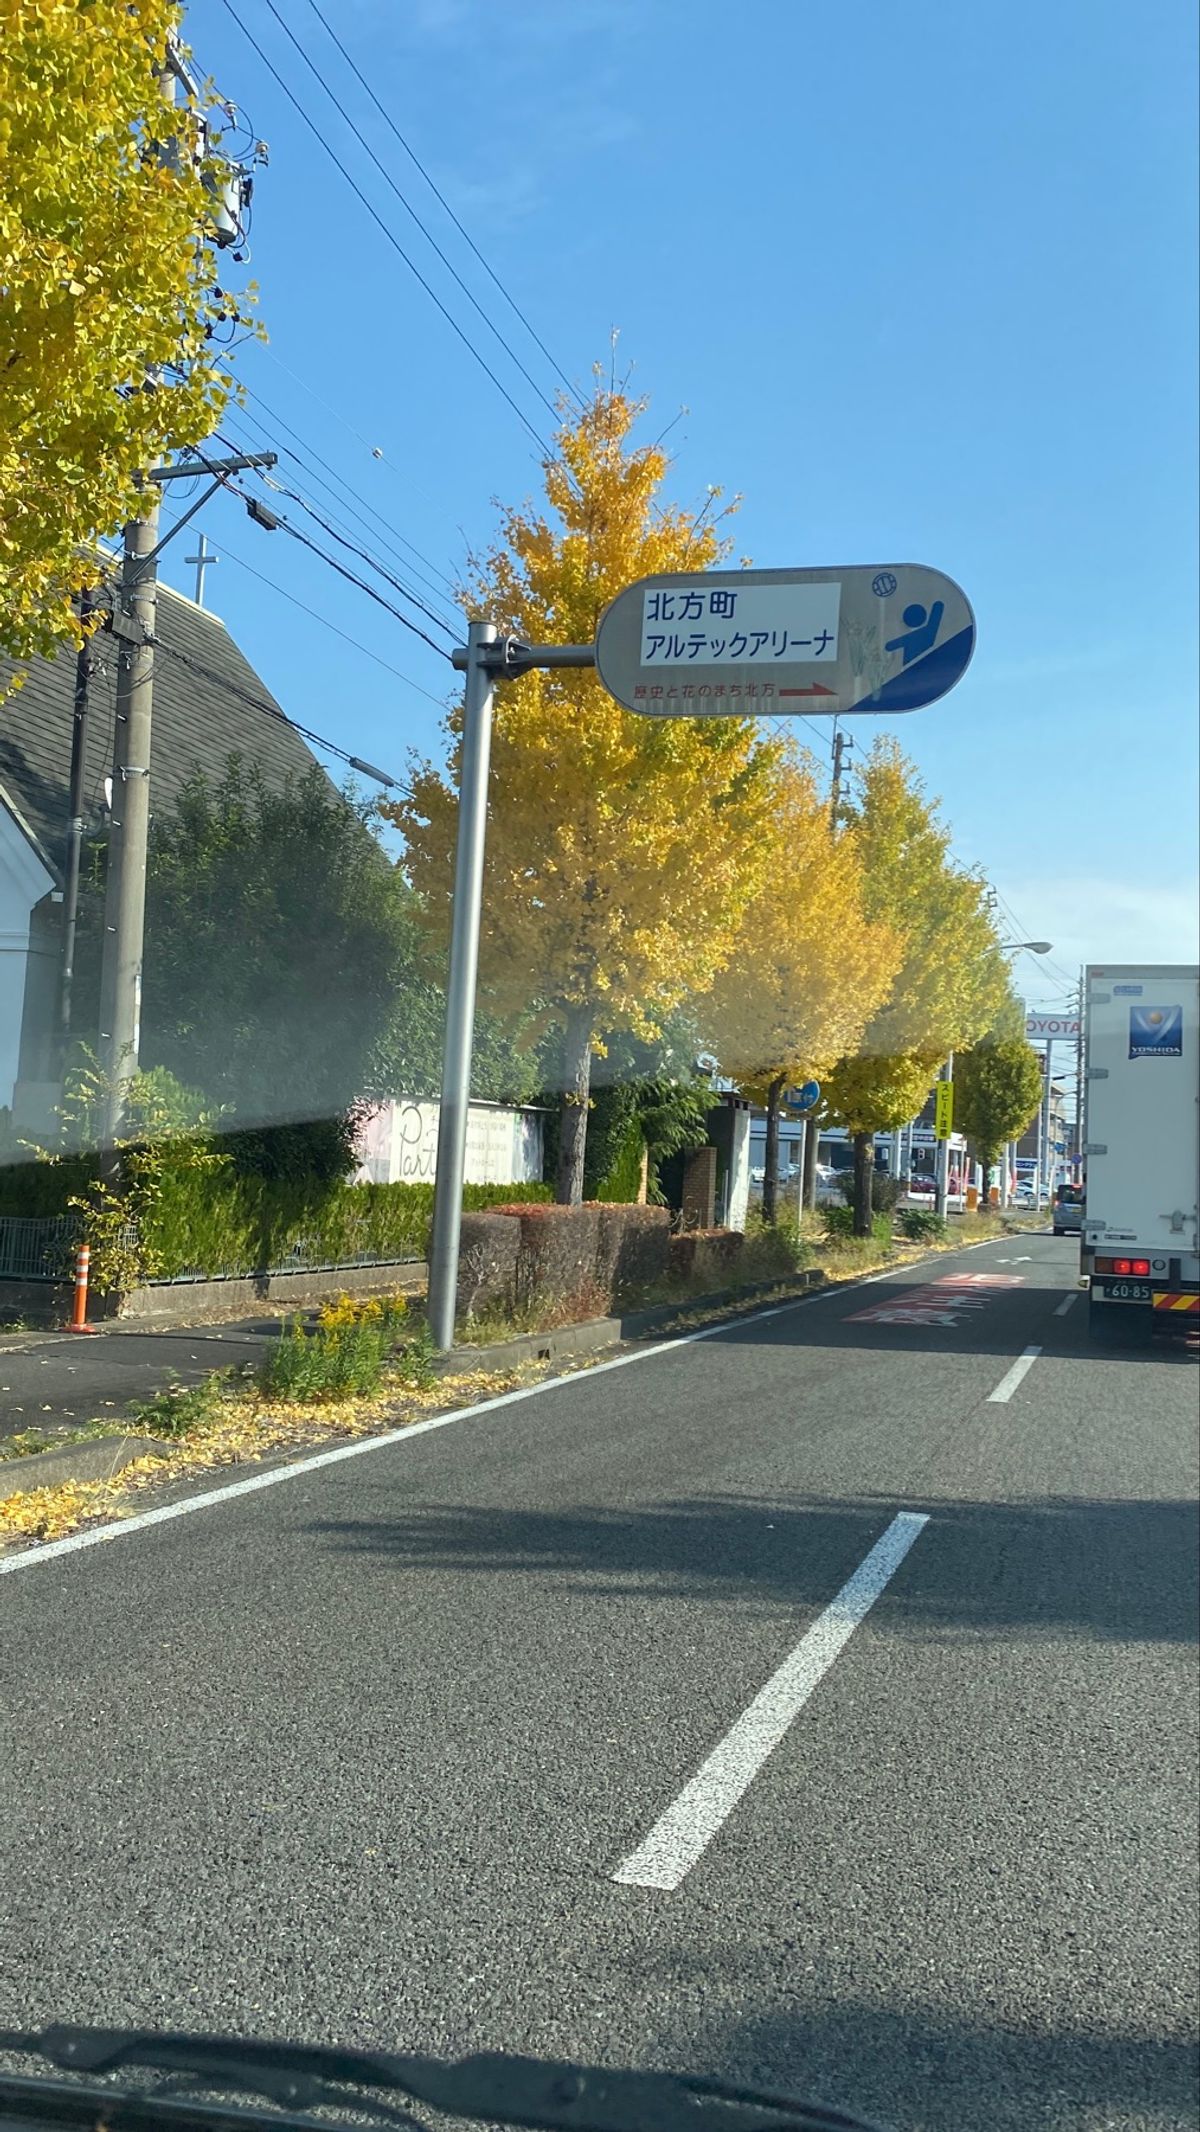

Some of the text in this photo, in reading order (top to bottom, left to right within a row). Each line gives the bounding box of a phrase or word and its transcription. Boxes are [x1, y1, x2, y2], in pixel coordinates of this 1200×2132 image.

[646, 591, 738, 621] 北方町
[645, 629, 835, 660] アルテックアリーナ
[633, 682, 776, 699] 歴史と花のまち北方
[1026, 1019, 1081, 1033] OYOTA
